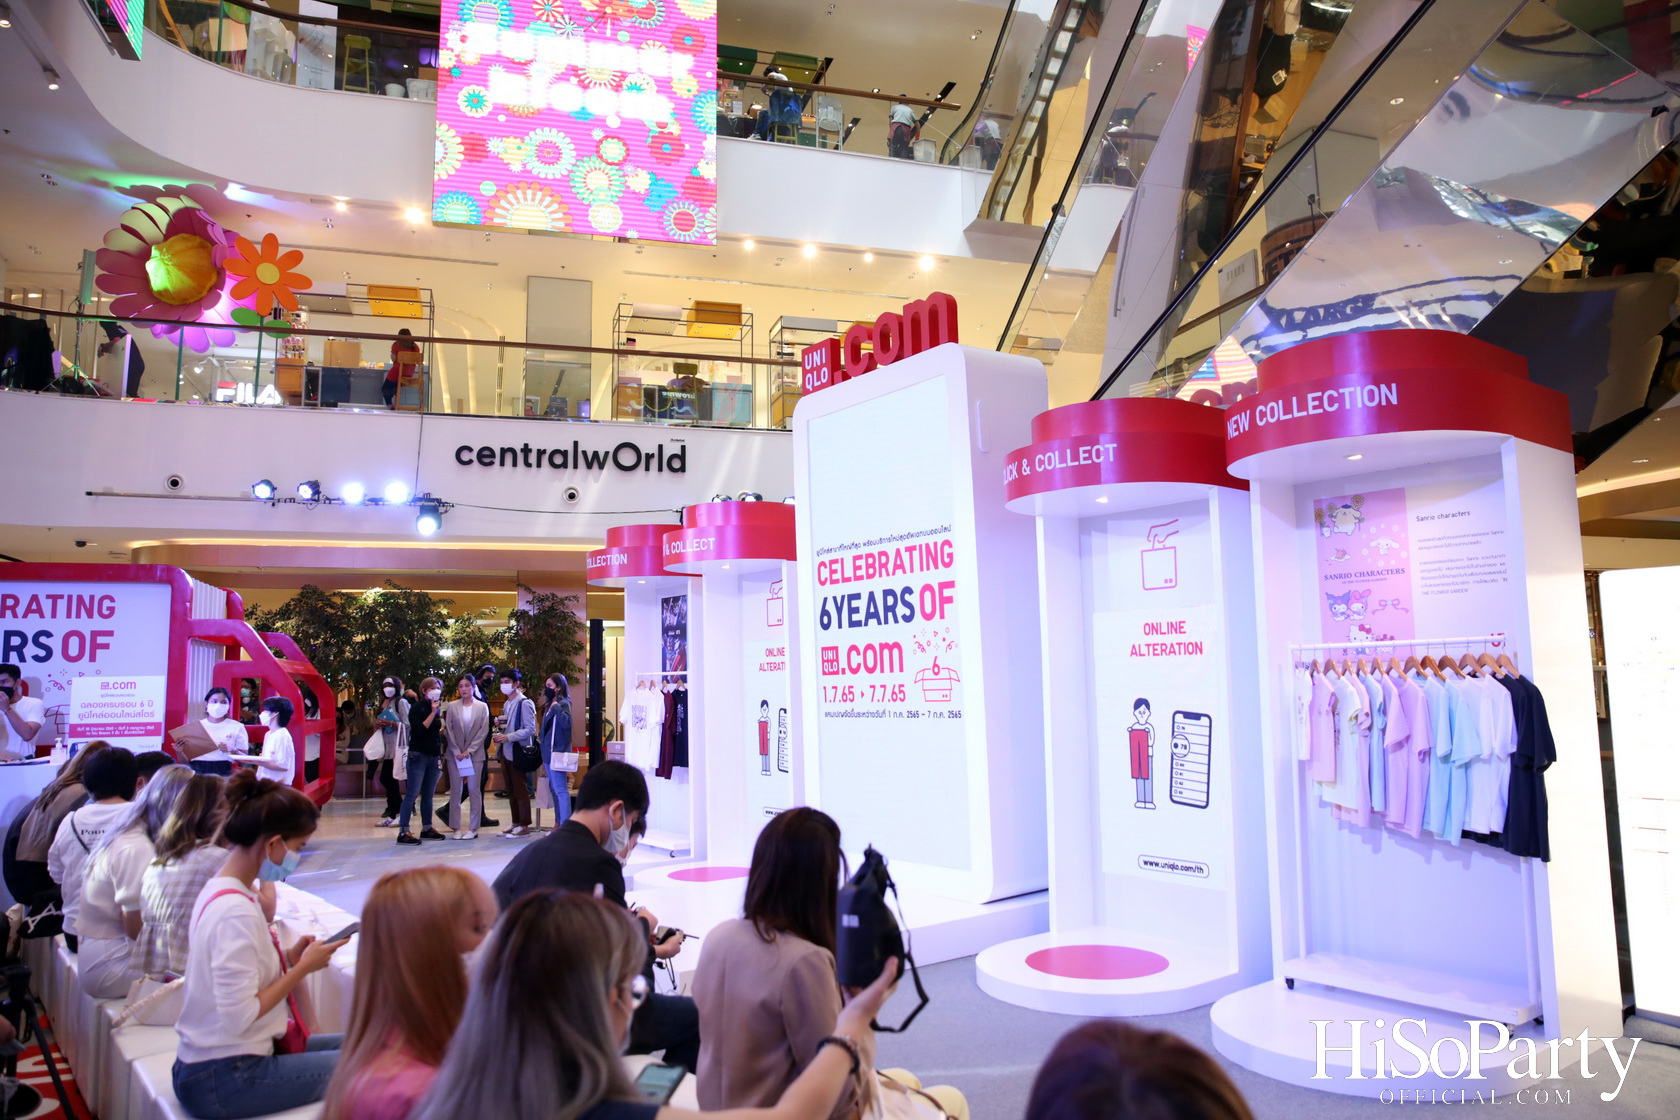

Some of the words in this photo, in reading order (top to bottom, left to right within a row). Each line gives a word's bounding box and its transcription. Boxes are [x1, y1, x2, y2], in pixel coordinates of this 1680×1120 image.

[834, 291, 957, 386] .com
[804, 347, 827, 370] UNI
[805, 366, 829, 391] QLO
[216, 382, 282, 405] FILA
[1227, 409, 1250, 441] NEW
[1255, 383, 1399, 427] COLLECTION
[1021, 458, 1031, 476] &
[1035, 443, 1118, 472] COLLECT
[1437, 510, 1471, 520] characters
[671, 537, 716, 553] COLLECT
[817, 539, 954, 586] CELEBRATING
[1324, 572, 1353, 581] SANRIO
[1354, 567, 1406, 579] CHARACTERS
[0, 594, 116, 619] RATING
[1143, 620, 1187, 636] ONLINE
[61, 629, 114, 664] OF
[765, 647, 785, 657] ONLINE
[823, 650, 837, 660] UNI
[1129, 641, 1203, 657] ALTERATION
[841, 641, 904, 675] .com
[931, 655, 941, 676] 6
[824, 662, 838, 674] QLO
[823, 685, 855, 703] 1.7.65
[869, 684, 906, 703] 7.7.65
[139, 700, 145, 708] 6
[907, 710, 920, 719] 2565
[947, 710, 962, 719] 2565
[1143, 859, 1205, 874] www.uniqlo.com/th
